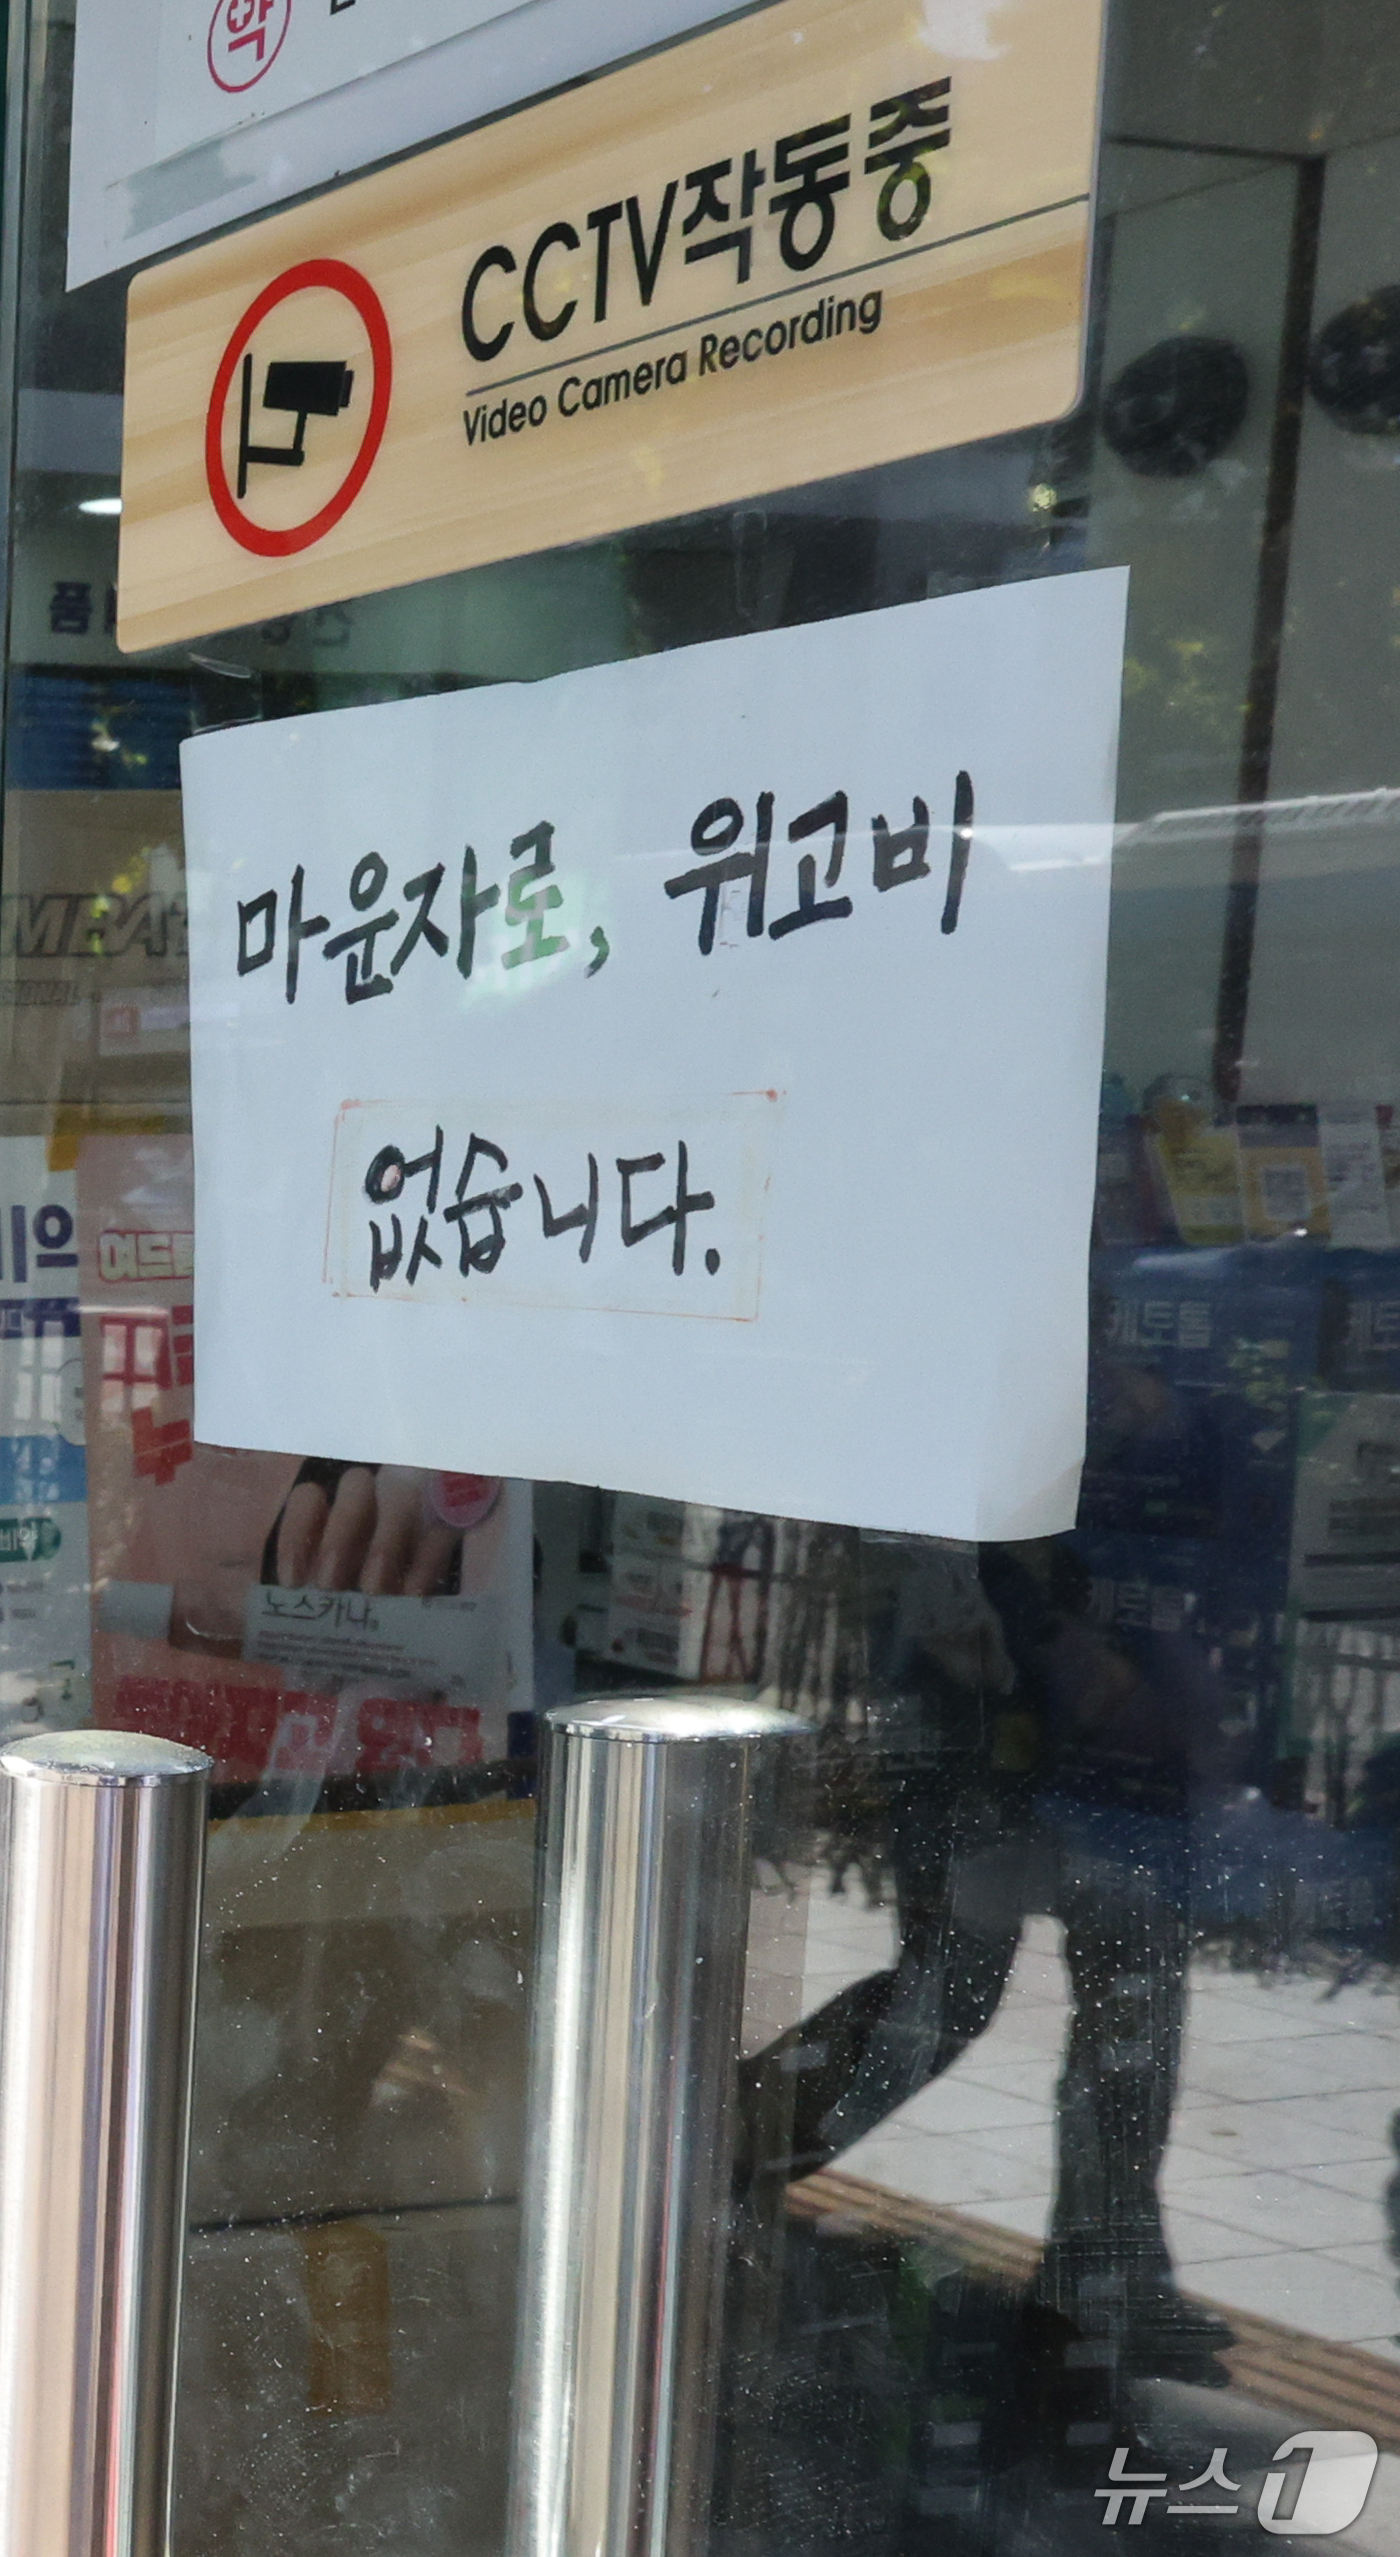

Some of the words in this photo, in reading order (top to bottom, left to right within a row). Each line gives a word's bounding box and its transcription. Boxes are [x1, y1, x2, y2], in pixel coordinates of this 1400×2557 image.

[461, 75, 952, 363] CCTV작동중
[463, 395, 548, 447] Video
[558, 350, 689, 418] Camera
[698, 290, 885, 378] Recording
[236, 820, 610, 1005] 마운자로,
[663, 770, 975, 956] 위고비
[364, 1124, 720, 1293] 없습니다.
